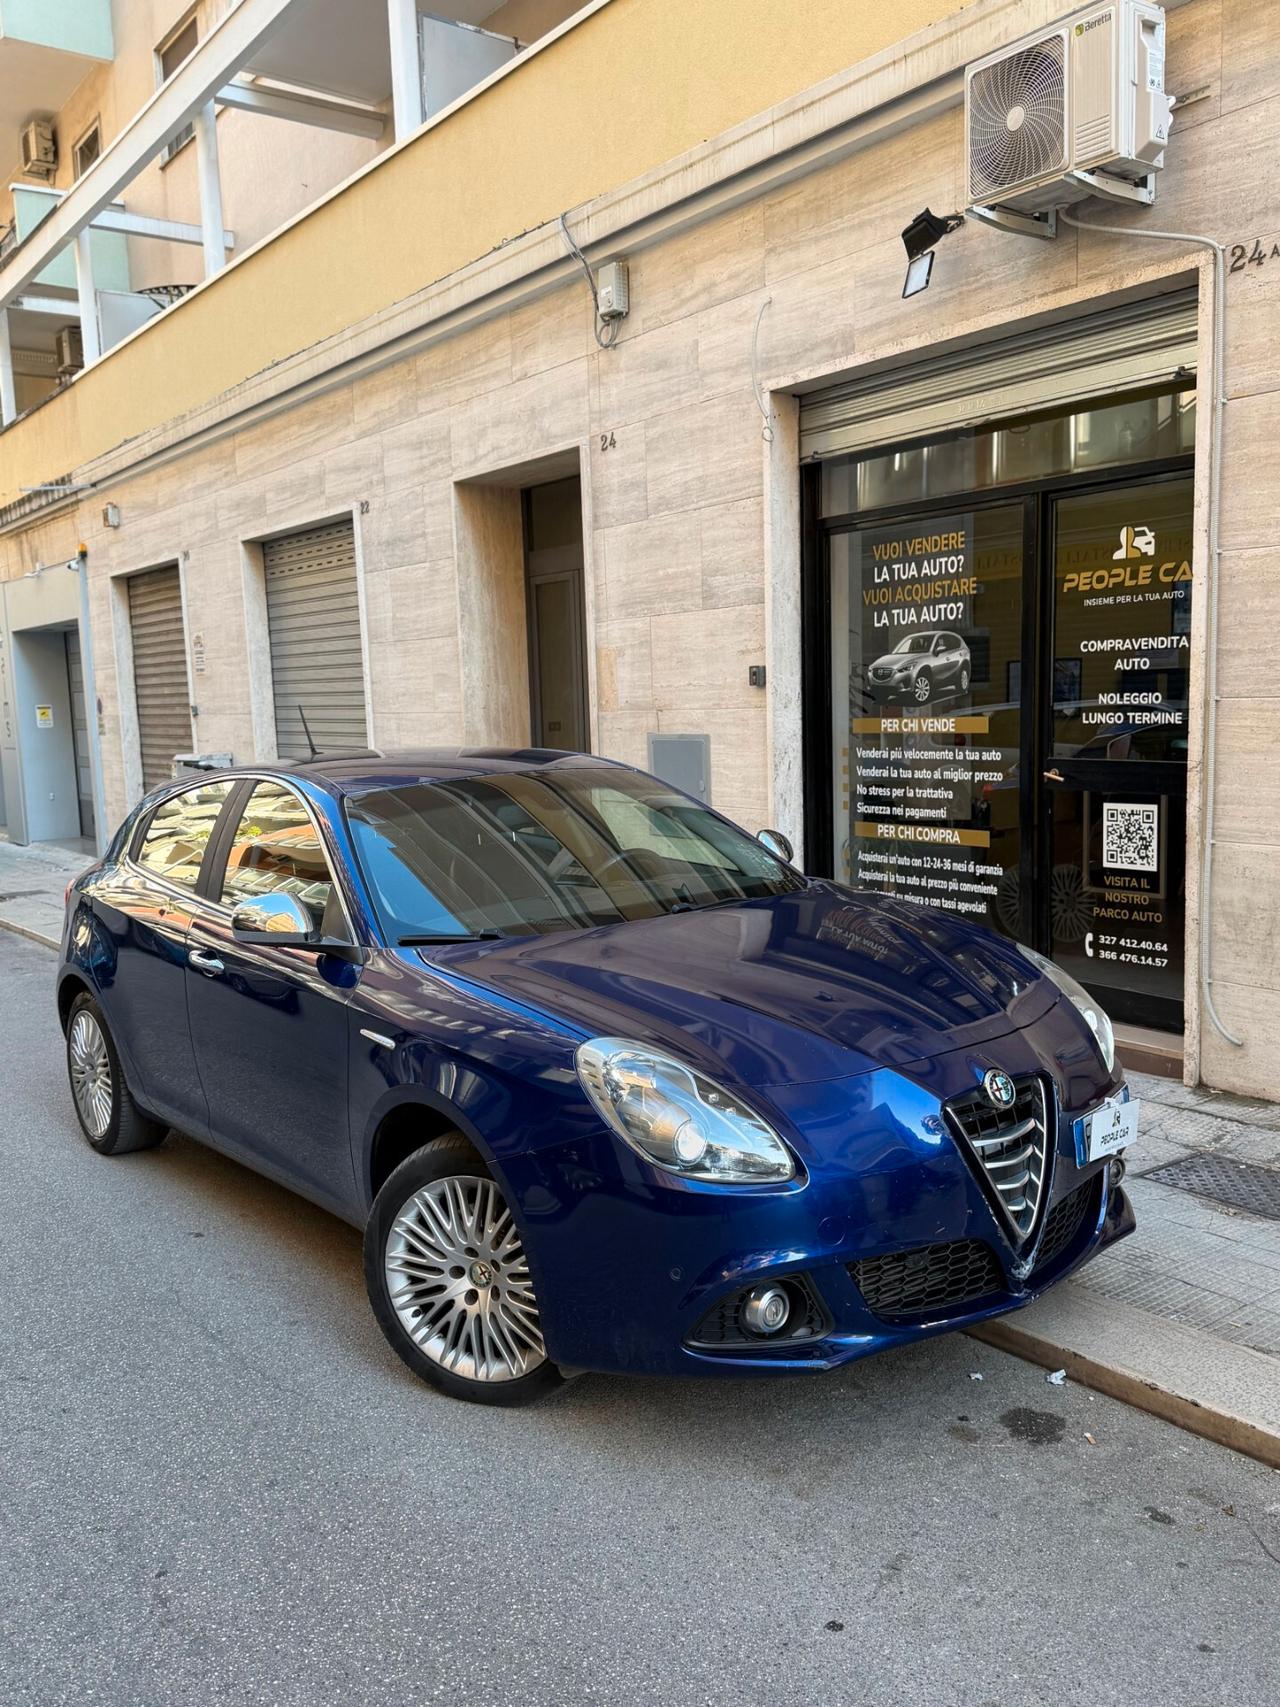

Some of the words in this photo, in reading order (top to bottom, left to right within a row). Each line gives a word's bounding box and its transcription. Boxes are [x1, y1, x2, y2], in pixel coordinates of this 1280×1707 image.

[1084, 13, 1112, 33] Beretta
[1230, 240, 1267, 273] 24
[1269, 243, 1280, 259] A
[600, 432, 617, 452] 24
[872, 541, 903, 561] VUOI
[905, 531, 966, 555] VENDERE
[873, 565, 890, 583] LA
[892, 561, 919, 581] TUA
[920, 554, 965, 577] AUTO?
[1063, 564, 1154, 592] PEOPLE
[1159, 560, 1193, 583] CA
[862, 586, 893, 606] VUOI
[895, 577, 978, 604] ACQUISTARE
[1083, 597, 1115, 606] INSIEME
[1116, 595, 1132, 603] PER
[1133, 594, 1143, 602] LA
[1145, 592, 1161, 601] TUA
[1162, 590, 1185, 599] AUTO
[873, 610, 890, 628] LA
[891, 607, 918, 626] TUA
[920, 602, 964, 622] AUTO?
[1080, 636, 1189, 652] COMPRAVENDITA
[1114, 658, 1150, 671] AUTO
[1098, 692, 1162, 704] NOLEGGIO
[881, 718, 900, 733] PER
[901, 718, 919, 733] CHI
[921, 718, 956, 732] VENDE
[1082, 713, 1124, 724] LUNGO
[1127, 712, 1182, 724] TERMINE
[856, 747, 889, 758] Venderai
[903, 748, 955, 760] velocemente
[955, 749, 964, 760] la
[965, 750, 980, 760] tua
[981, 750, 1002, 761] auto
[856, 766, 889, 777] Venderai
[890, 767, 898, 778] la
[899, 769, 913, 778] tua
[913, 769, 932, 780] auto
[933, 769, 941, 780] al
[943, 768, 972, 783] miglior
[974, 773, 1003, 782] prezzo
[856, 784, 867, 796] No
[868, 786, 891, 797] stress
[892, 788, 905, 799] per
[906, 786, 915, 797] la
[915, 787, 954, 799] trattativa
[856, 802, 891, 815] Sicurezza
[892, 804, 904, 816] nei
[905, 806, 947, 819] pagamenti
[877, 824, 896, 838] PER
[898, 827, 915, 840] CHI
[916, 828, 961, 844] COMPRA
[858, 850, 888, 864] Acquisterai
[889, 853, 911, 866] un'auto
[911, 856, 922, 867] con
[923, 856, 952, 870] 12-24-36
[952, 860, 967, 872] mesi
[967, 861, 975, 873] di
[975, 863, 1003, 876] garanzia
[858, 868, 889, 882] Acquisterai
[889, 871, 896, 882] la
[896, 873, 906, 883] tua
[906, 874, 920, 885] auto
[921, 875, 927, 887] al
[927, 879, 948, 890] prezzo
[959, 881, 998, 895] conveniente
[1104, 876, 1138, 887] VISITA
[1141, 879, 1150, 888] IL
[924, 897, 929, 905] o
[929, 898, 941, 908] con
[941, 897, 957, 910] tassi
[957, 901, 987, 914] agevolati
[1105, 892, 1149, 905] NOSTRO
[1093, 907, 1129, 920] PARCO
[1131, 911, 1163, 923] AUTO
[1099, 935, 1117, 945] 327
[1119, 938, 1168, 952] 412.40.64
[1099, 950, 1117, 961] 366
[1119, 954, 1168, 967] 476.14.57
[1101, 1131, 1119, 1146] PEOPLE
